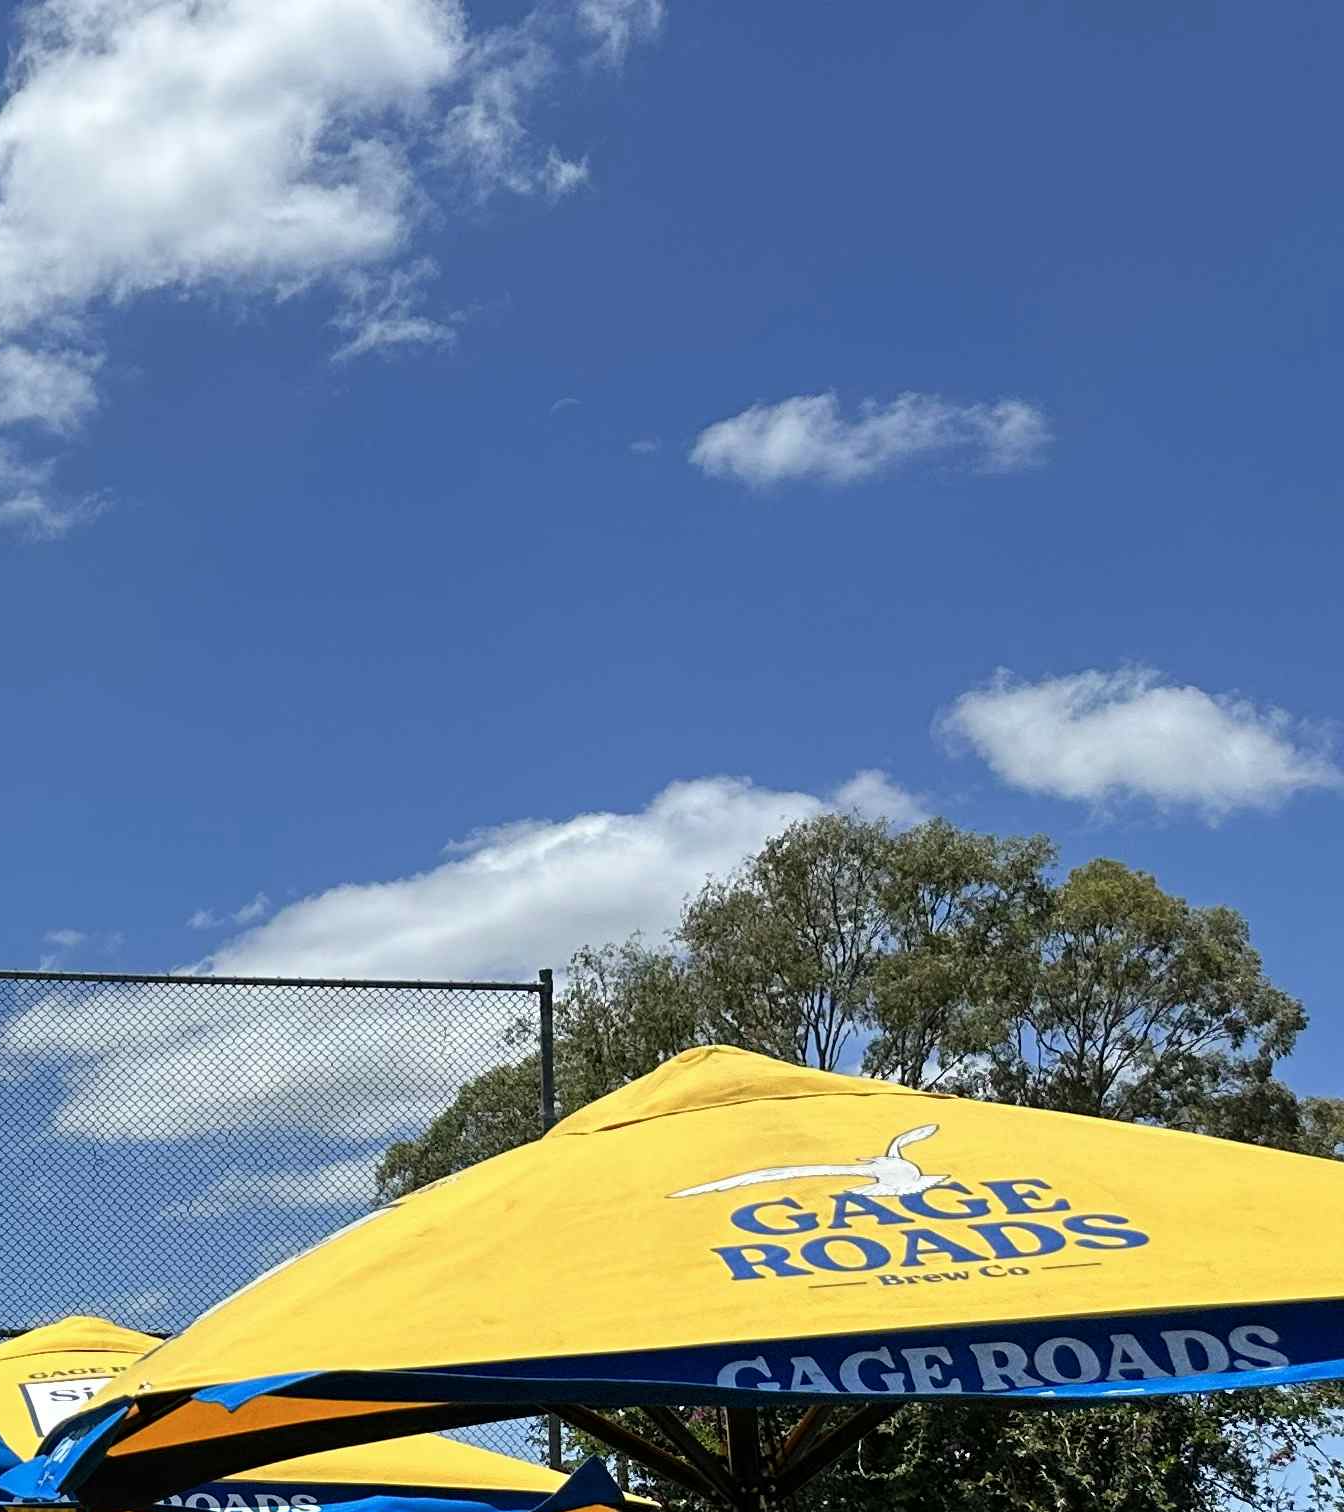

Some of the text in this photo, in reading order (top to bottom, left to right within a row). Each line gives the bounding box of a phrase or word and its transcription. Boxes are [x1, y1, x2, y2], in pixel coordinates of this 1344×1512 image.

[730, 1178, 1072, 1236] GAGE
[710, 1213, 1150, 1281] ROADS
[877, 1263, 1030, 1287] Brew Co
[28, 1367, 106, 1380] GAGE
[715, 1324, 1290, 1395] GAGE ROADS
